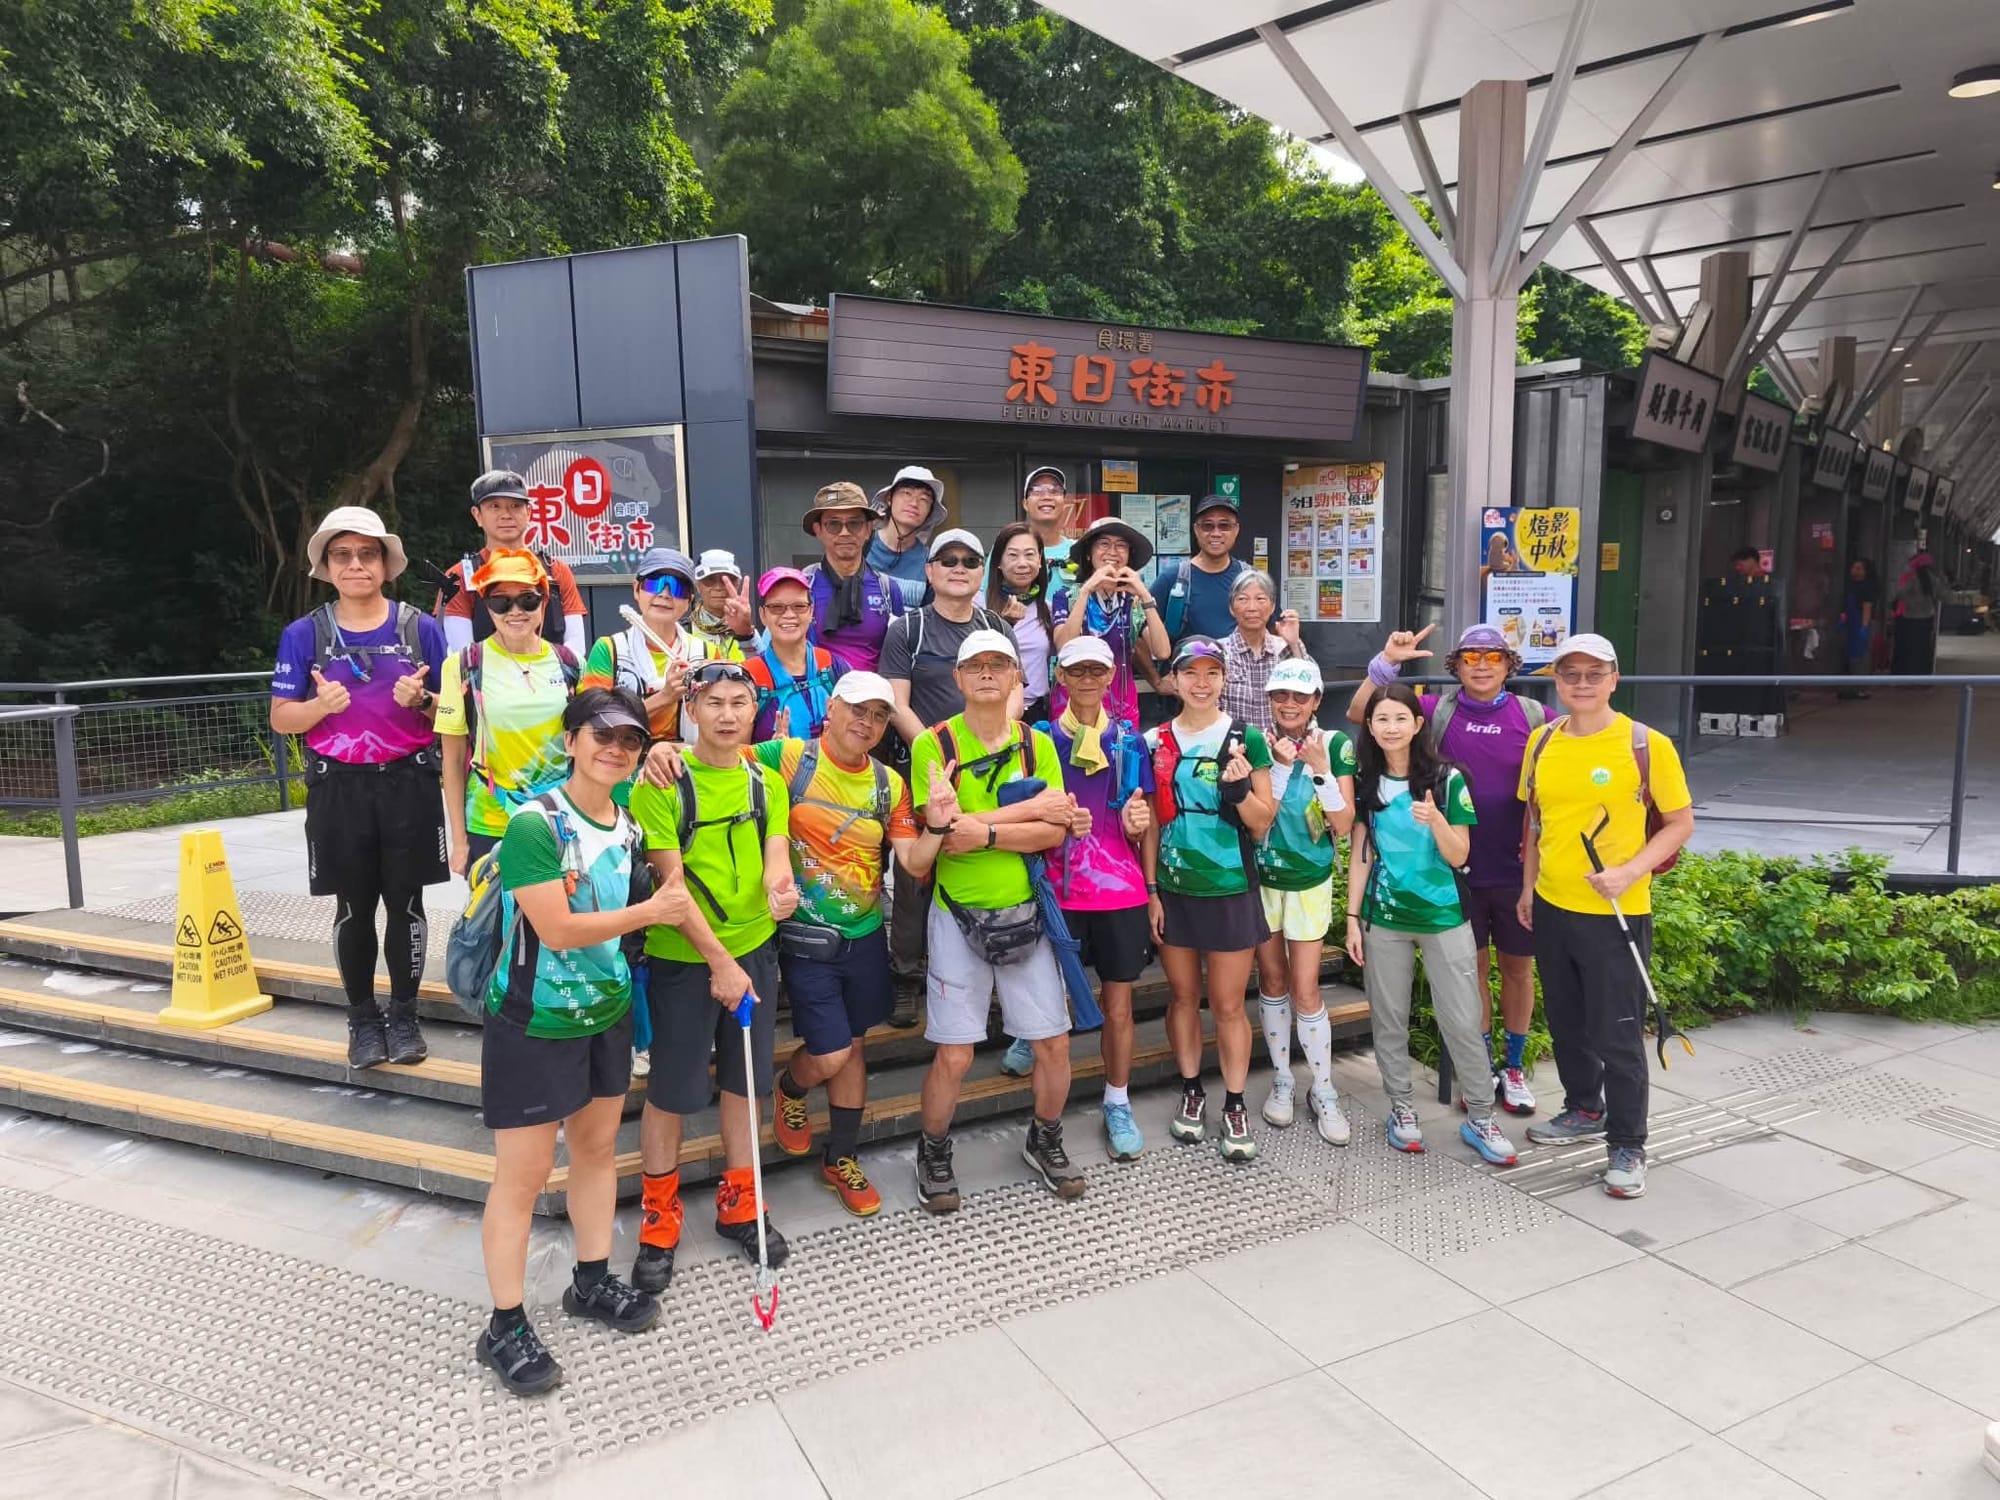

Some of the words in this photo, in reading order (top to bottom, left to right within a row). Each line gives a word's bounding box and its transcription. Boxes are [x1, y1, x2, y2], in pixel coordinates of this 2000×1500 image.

[1098, 328, 1153, 352] 食環署
[1006, 342, 1236, 413] 東日街市
[1002, 406, 1050, 420] FEHD
[1061, 408, 1151, 426] SUNLIGHT
[1162, 414, 1229, 432] MARKET
[1530, 534, 1567, 566] 中秋
[179, 962, 199, 971] CAUTION
[213, 970, 226, 981] WET
[227, 964, 248, 977] FLOOR
[215, 953, 242, 968] CAUTION
